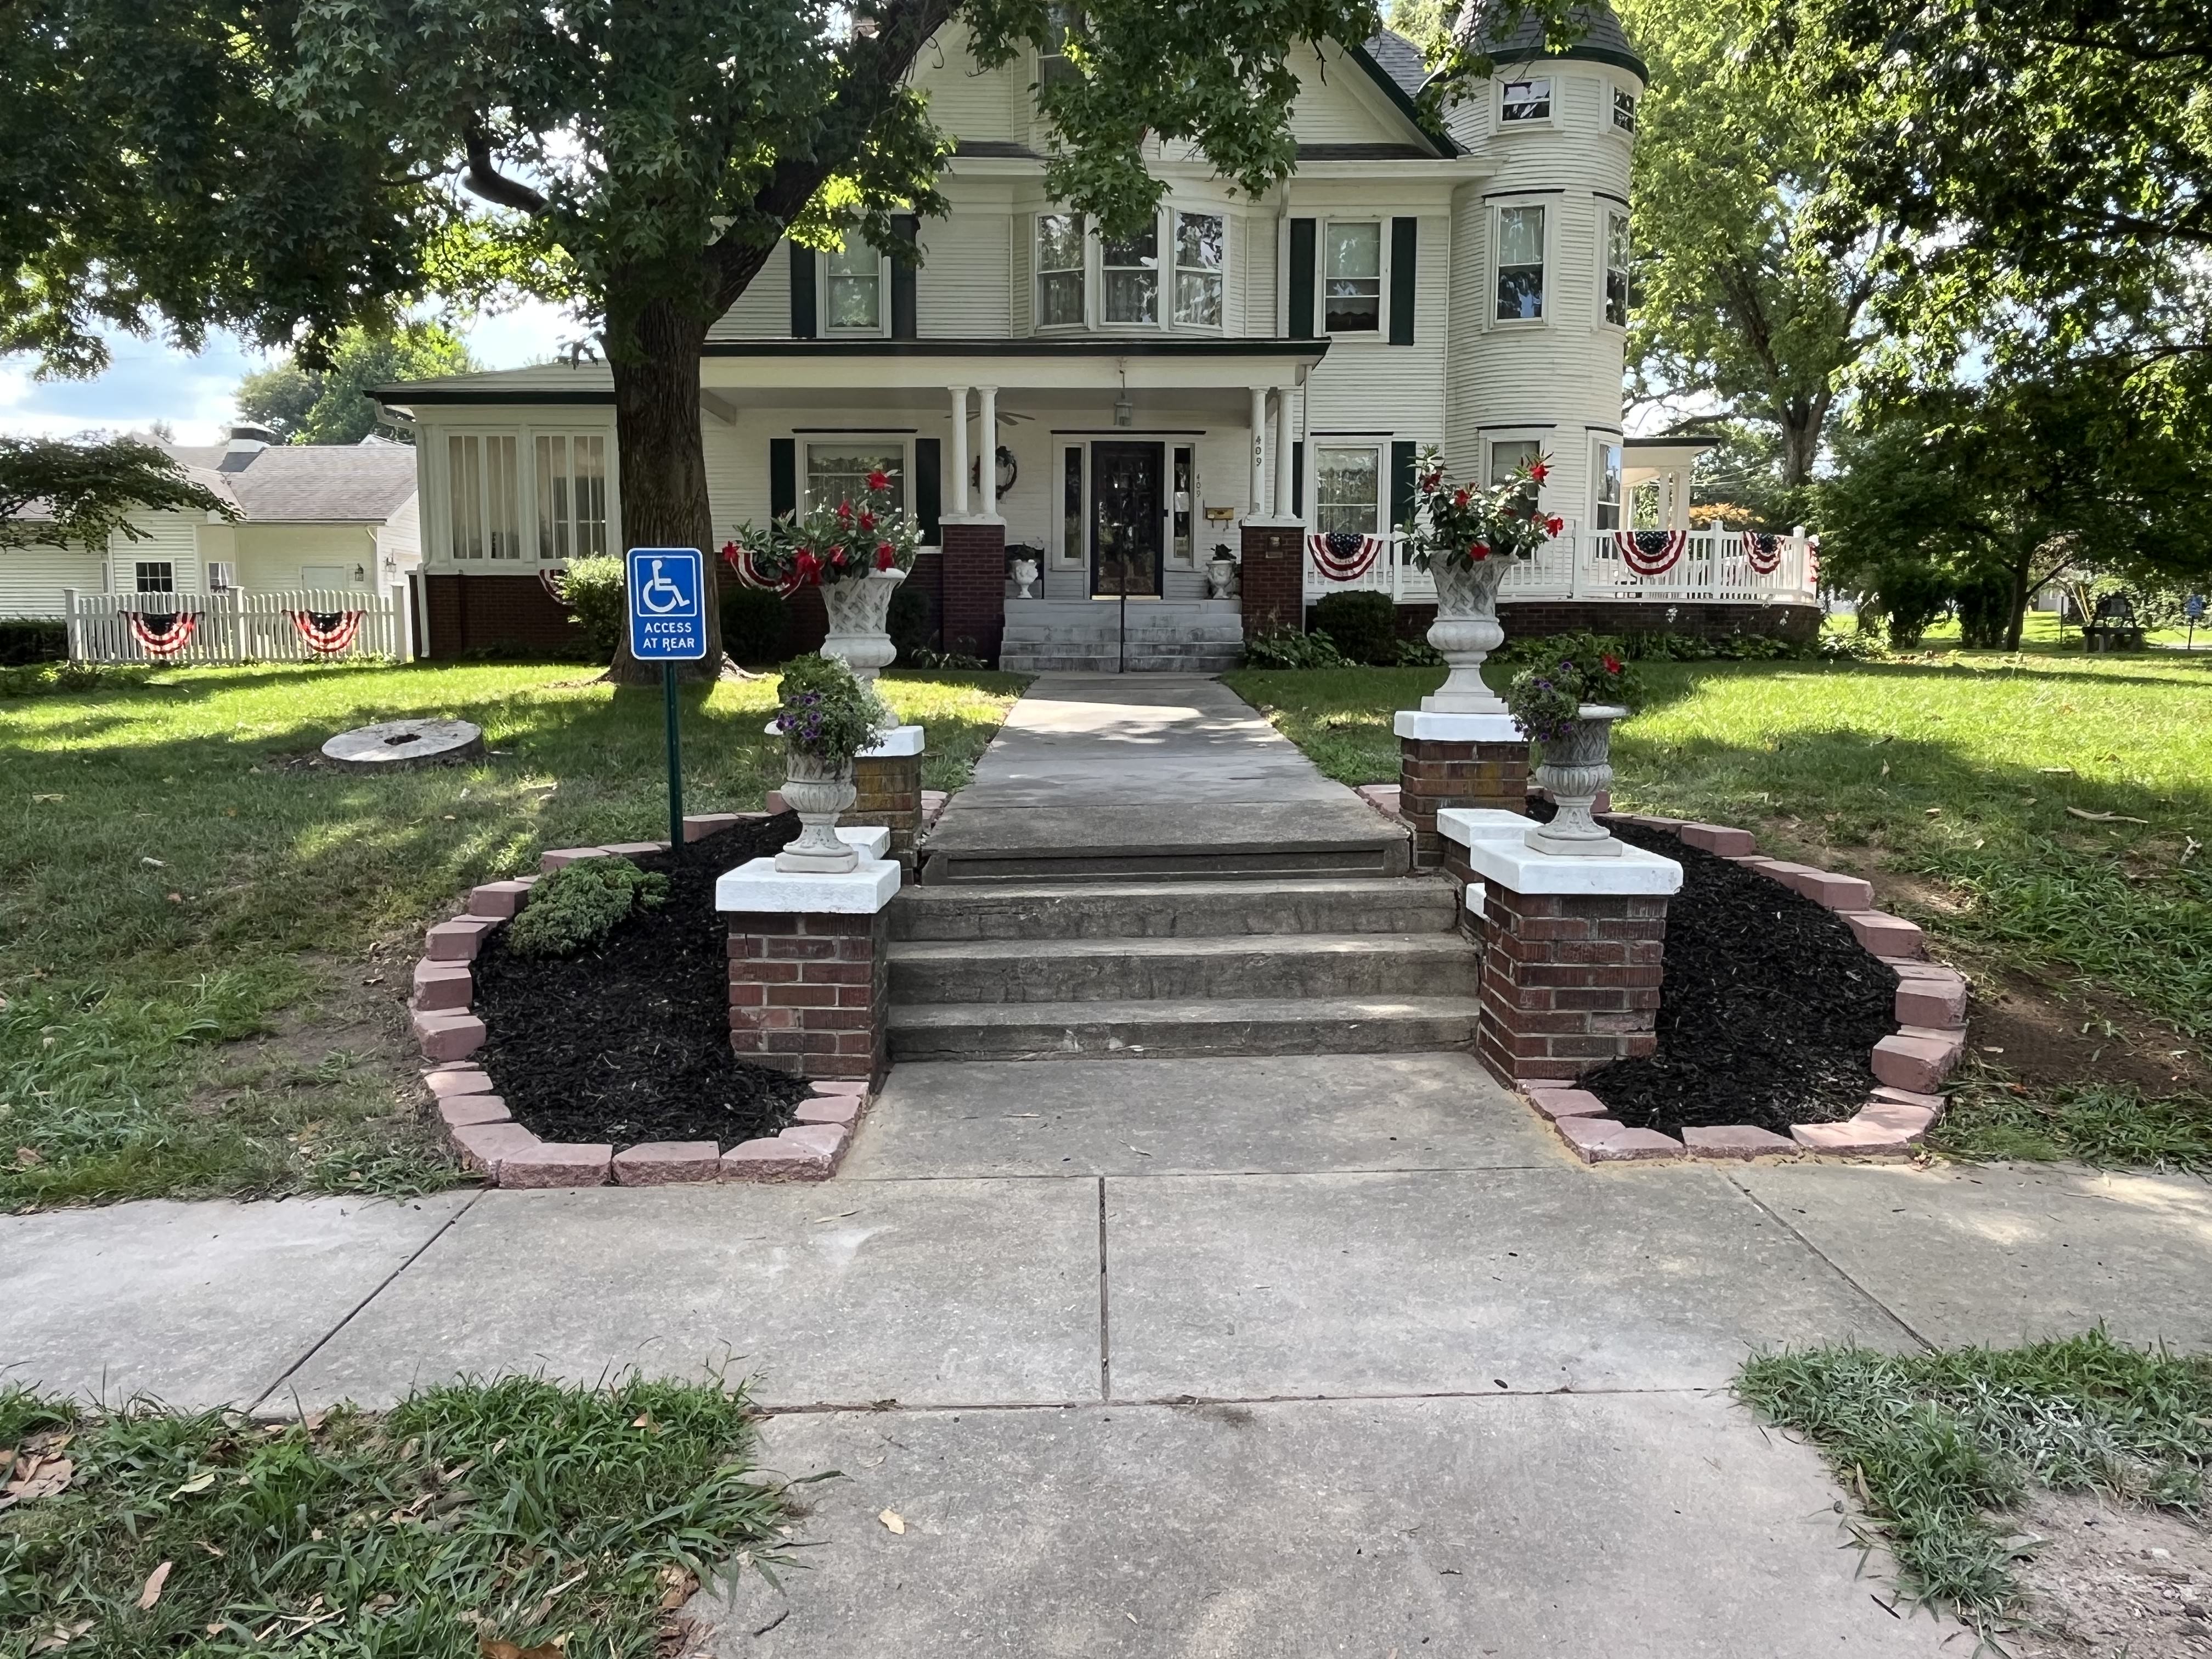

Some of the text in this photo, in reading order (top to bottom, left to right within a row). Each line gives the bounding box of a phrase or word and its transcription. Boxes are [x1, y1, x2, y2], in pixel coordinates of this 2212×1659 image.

[644, 622, 692, 633] ACCESS
[643, 637, 695, 648] AT REAR
